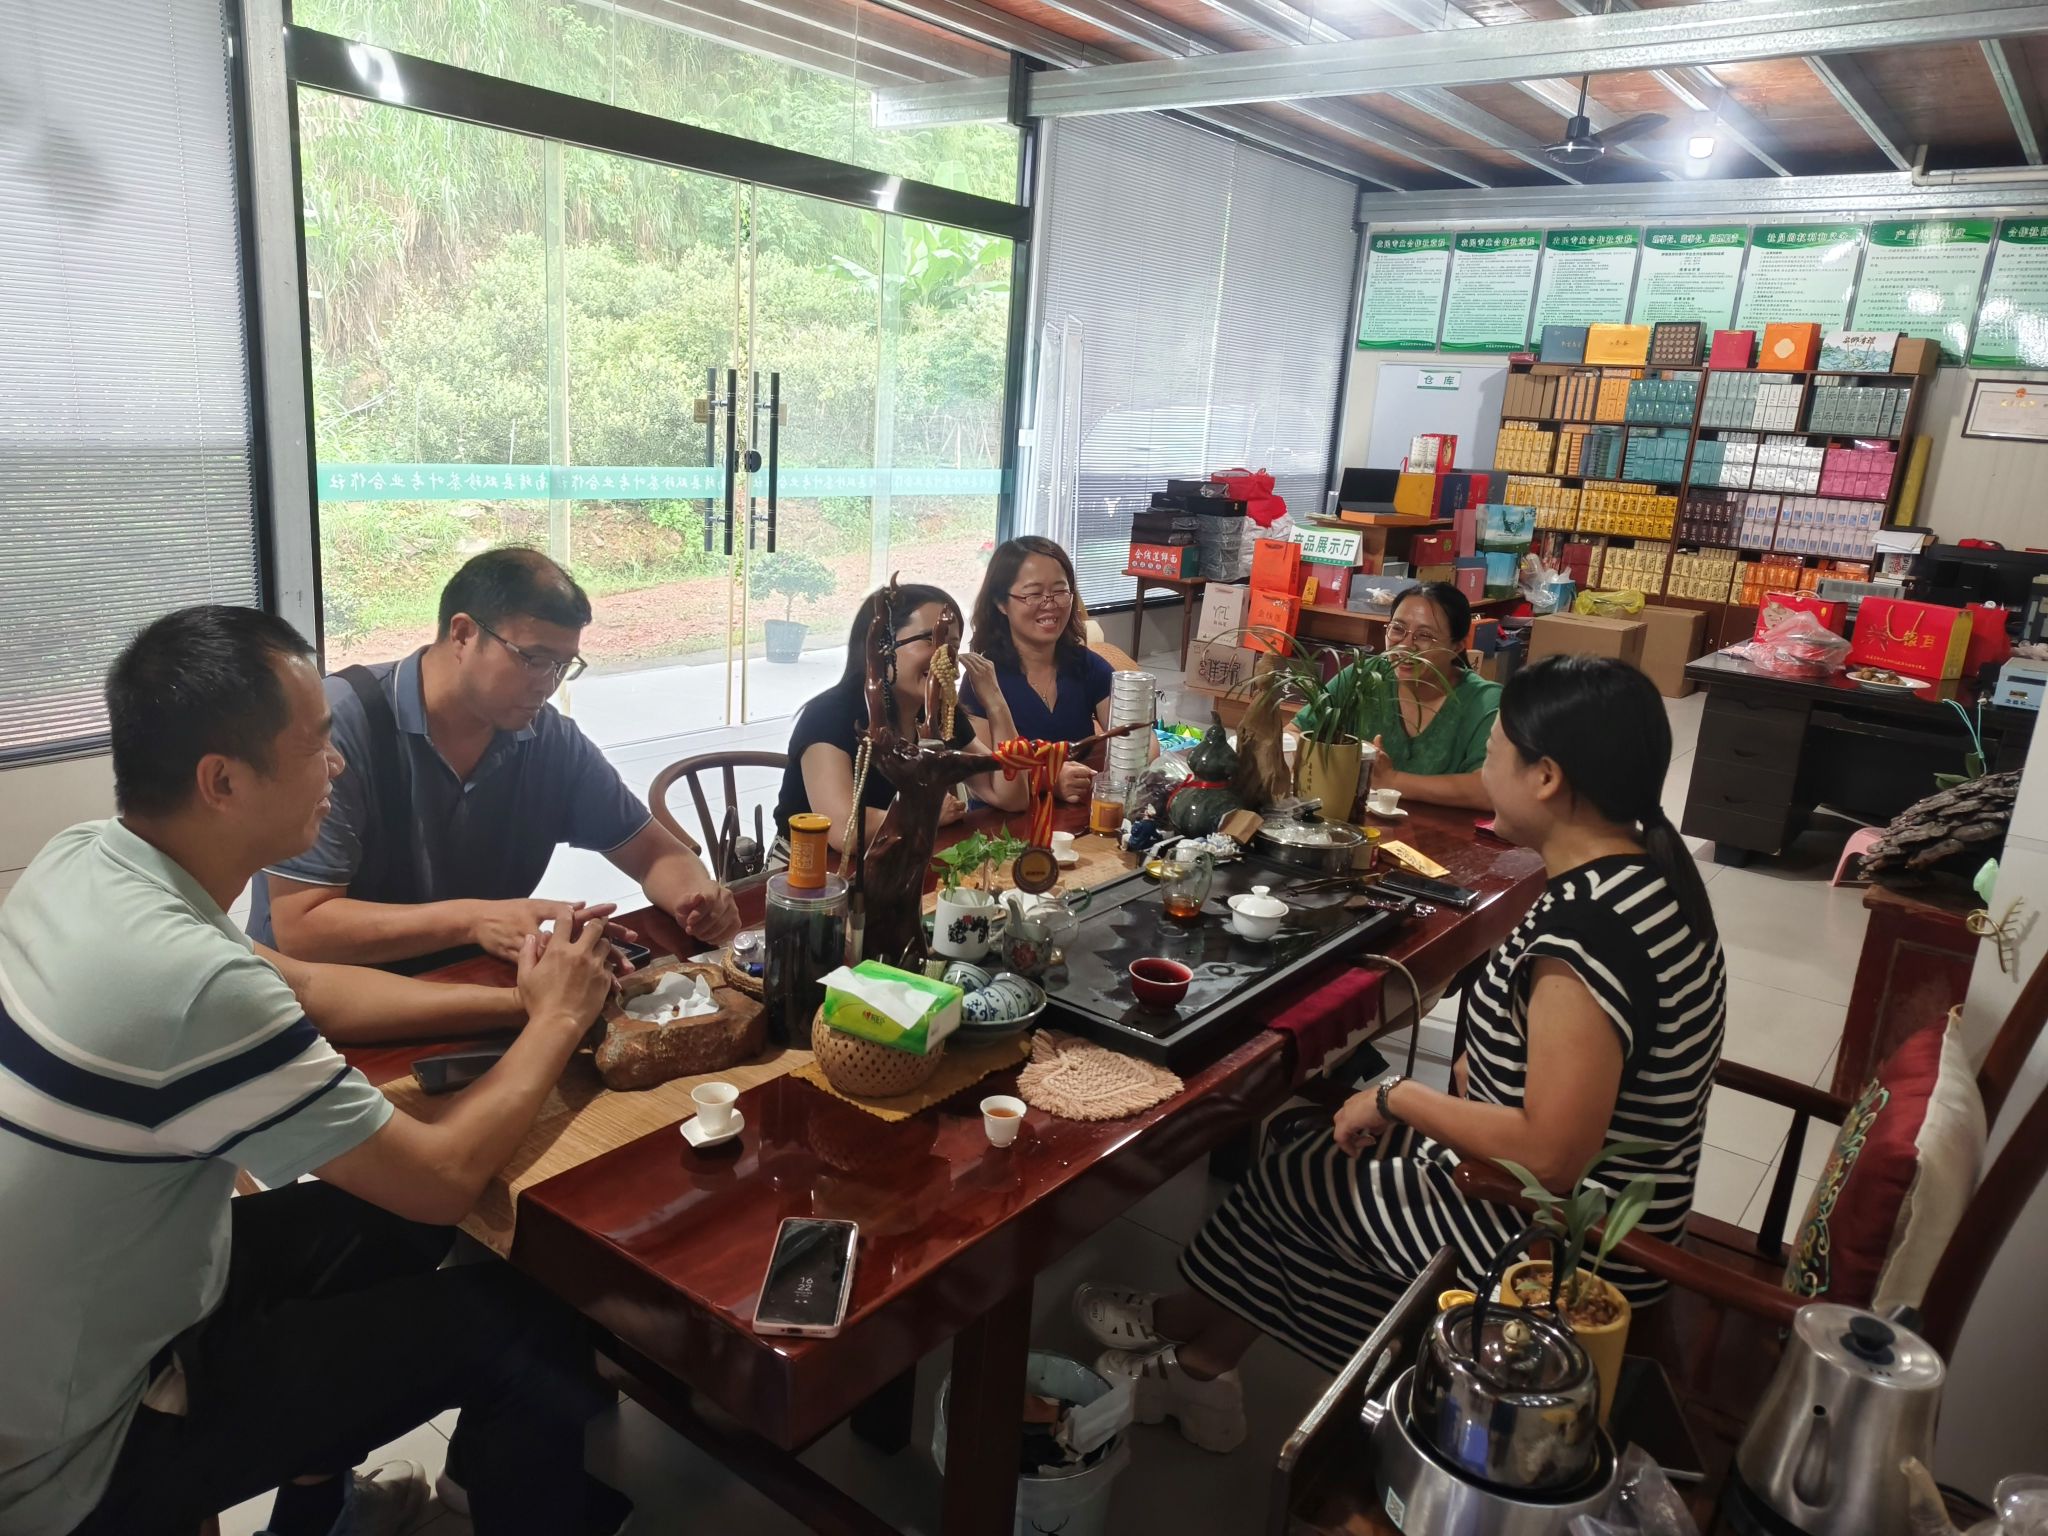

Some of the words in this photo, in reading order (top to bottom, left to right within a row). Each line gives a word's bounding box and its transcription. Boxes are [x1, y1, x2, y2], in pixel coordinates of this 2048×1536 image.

[1424, 375, 1455, 386] 仓库
[1294, 533, 1355, 556] 产品展示厅
